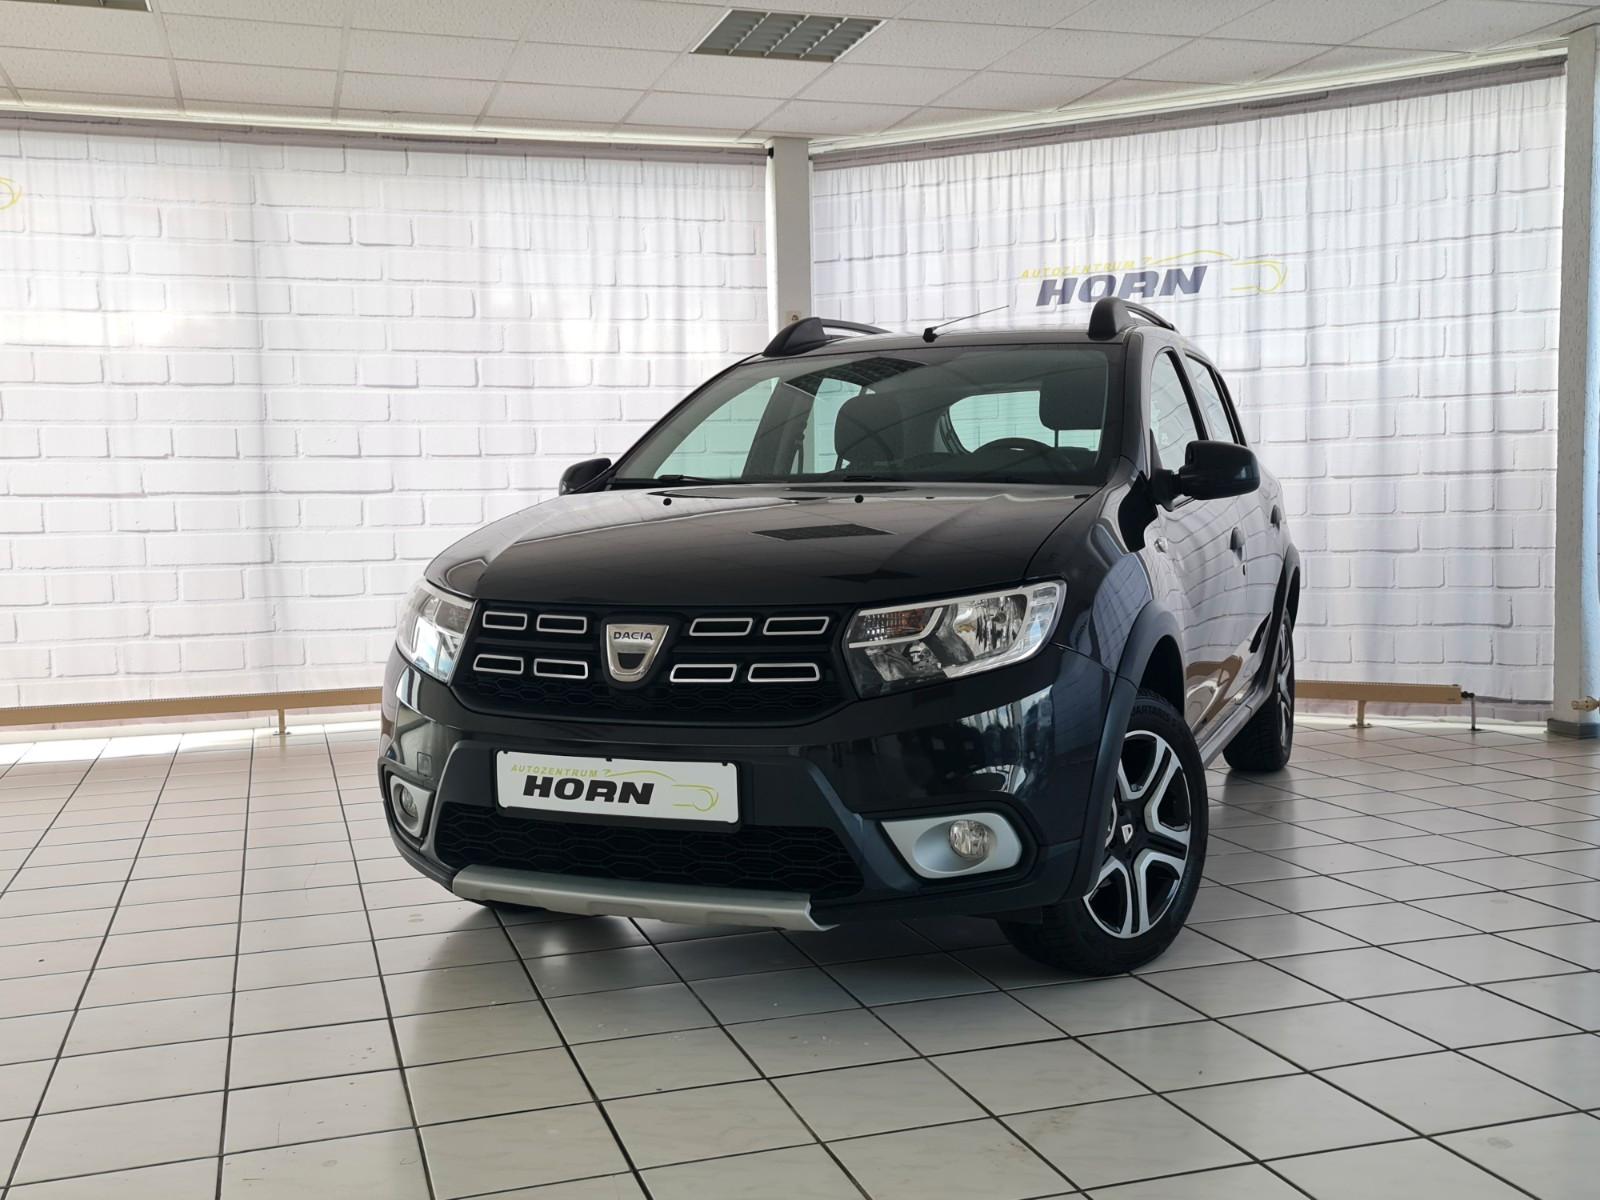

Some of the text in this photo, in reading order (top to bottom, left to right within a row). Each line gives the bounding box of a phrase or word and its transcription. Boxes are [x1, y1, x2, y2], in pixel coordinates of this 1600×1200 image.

[1022, 261, 1136, 279] AUTOZENTRUM
[1036, 265, 1208, 306] HORN
[613, 631, 653, 640] DACIA
[511, 764, 598, 777] AUTOZENTRUM
[523, 775, 655, 805] HORN
